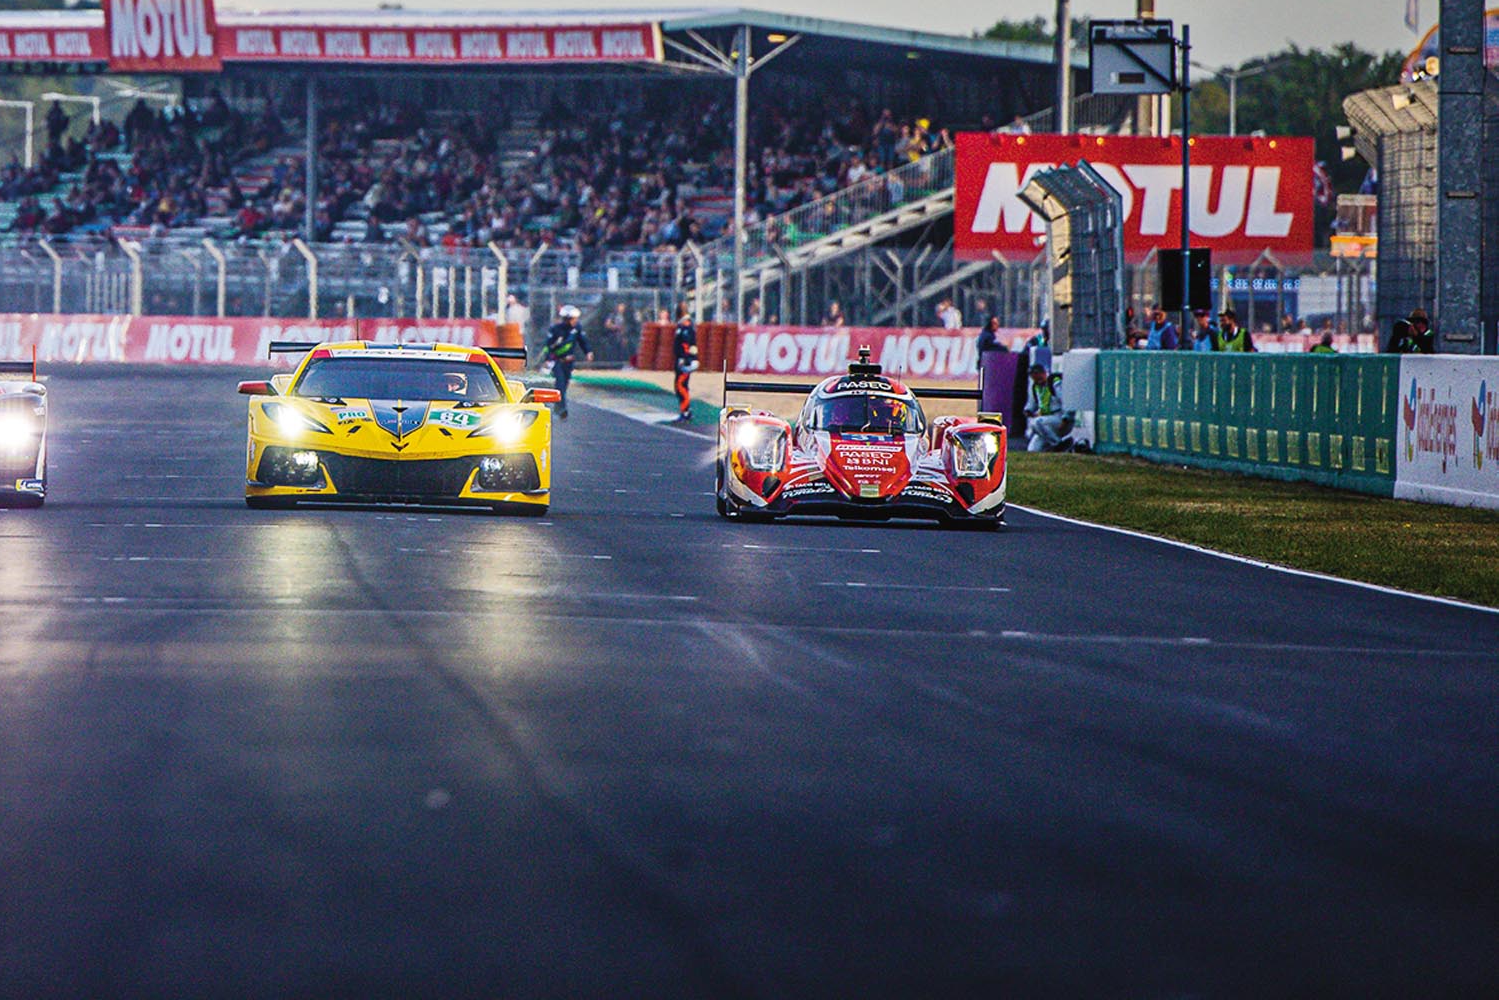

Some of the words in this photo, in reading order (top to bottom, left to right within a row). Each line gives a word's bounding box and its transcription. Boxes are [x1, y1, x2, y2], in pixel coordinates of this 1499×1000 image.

[970, 161, 1294, 239] MTUL
[145, 324, 236, 362] MOTUL
[738, 331, 852, 371] MOTUL
[879, 333, 979, 374] MOTU
[837, 381, 892, 391] PASEO
[839, 451, 893, 459] PASEO
